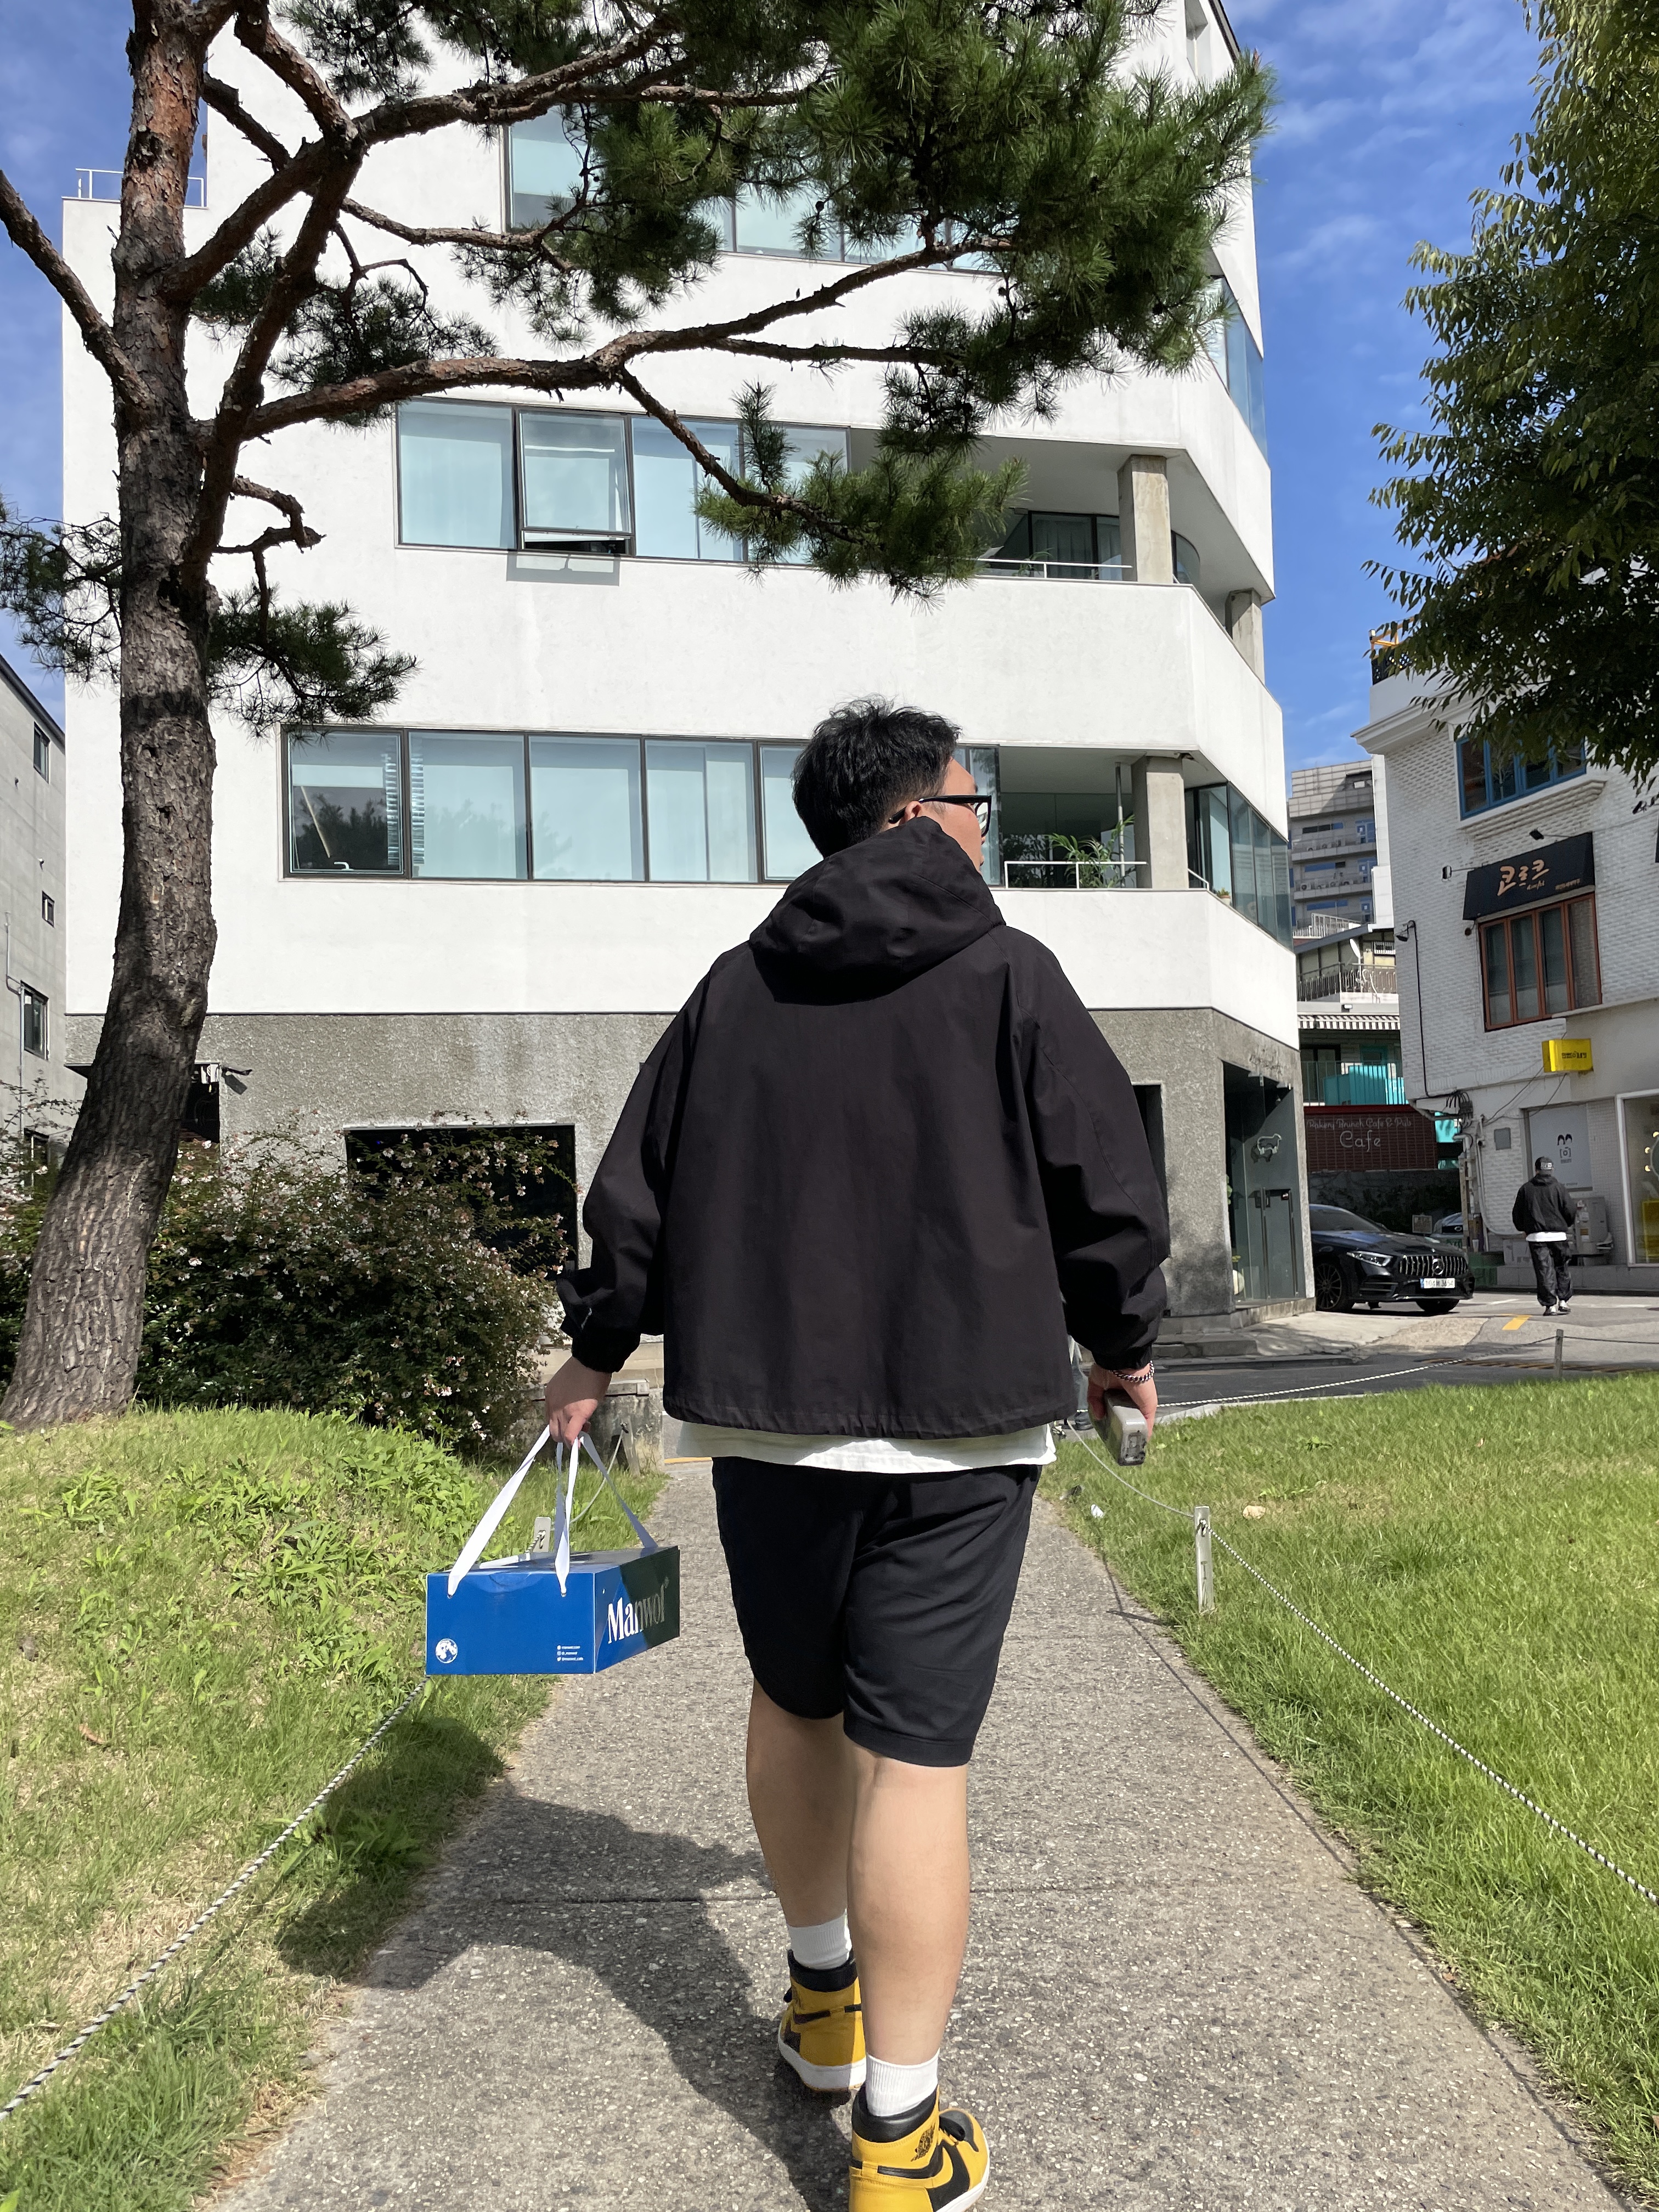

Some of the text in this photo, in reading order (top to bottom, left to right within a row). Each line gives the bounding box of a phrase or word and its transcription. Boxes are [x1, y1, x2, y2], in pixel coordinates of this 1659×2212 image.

[1497, 859, 1549, 896] 코르크
[1336, 1118, 1364, 1128] Brunch
[1365, 1117, 1384, 1129] Cafe
[1394, 1117, 1412, 1127] Pub
[1339, 1130, 1381, 1152] Cafe
[608, 1584, 665, 1644] Manwol
